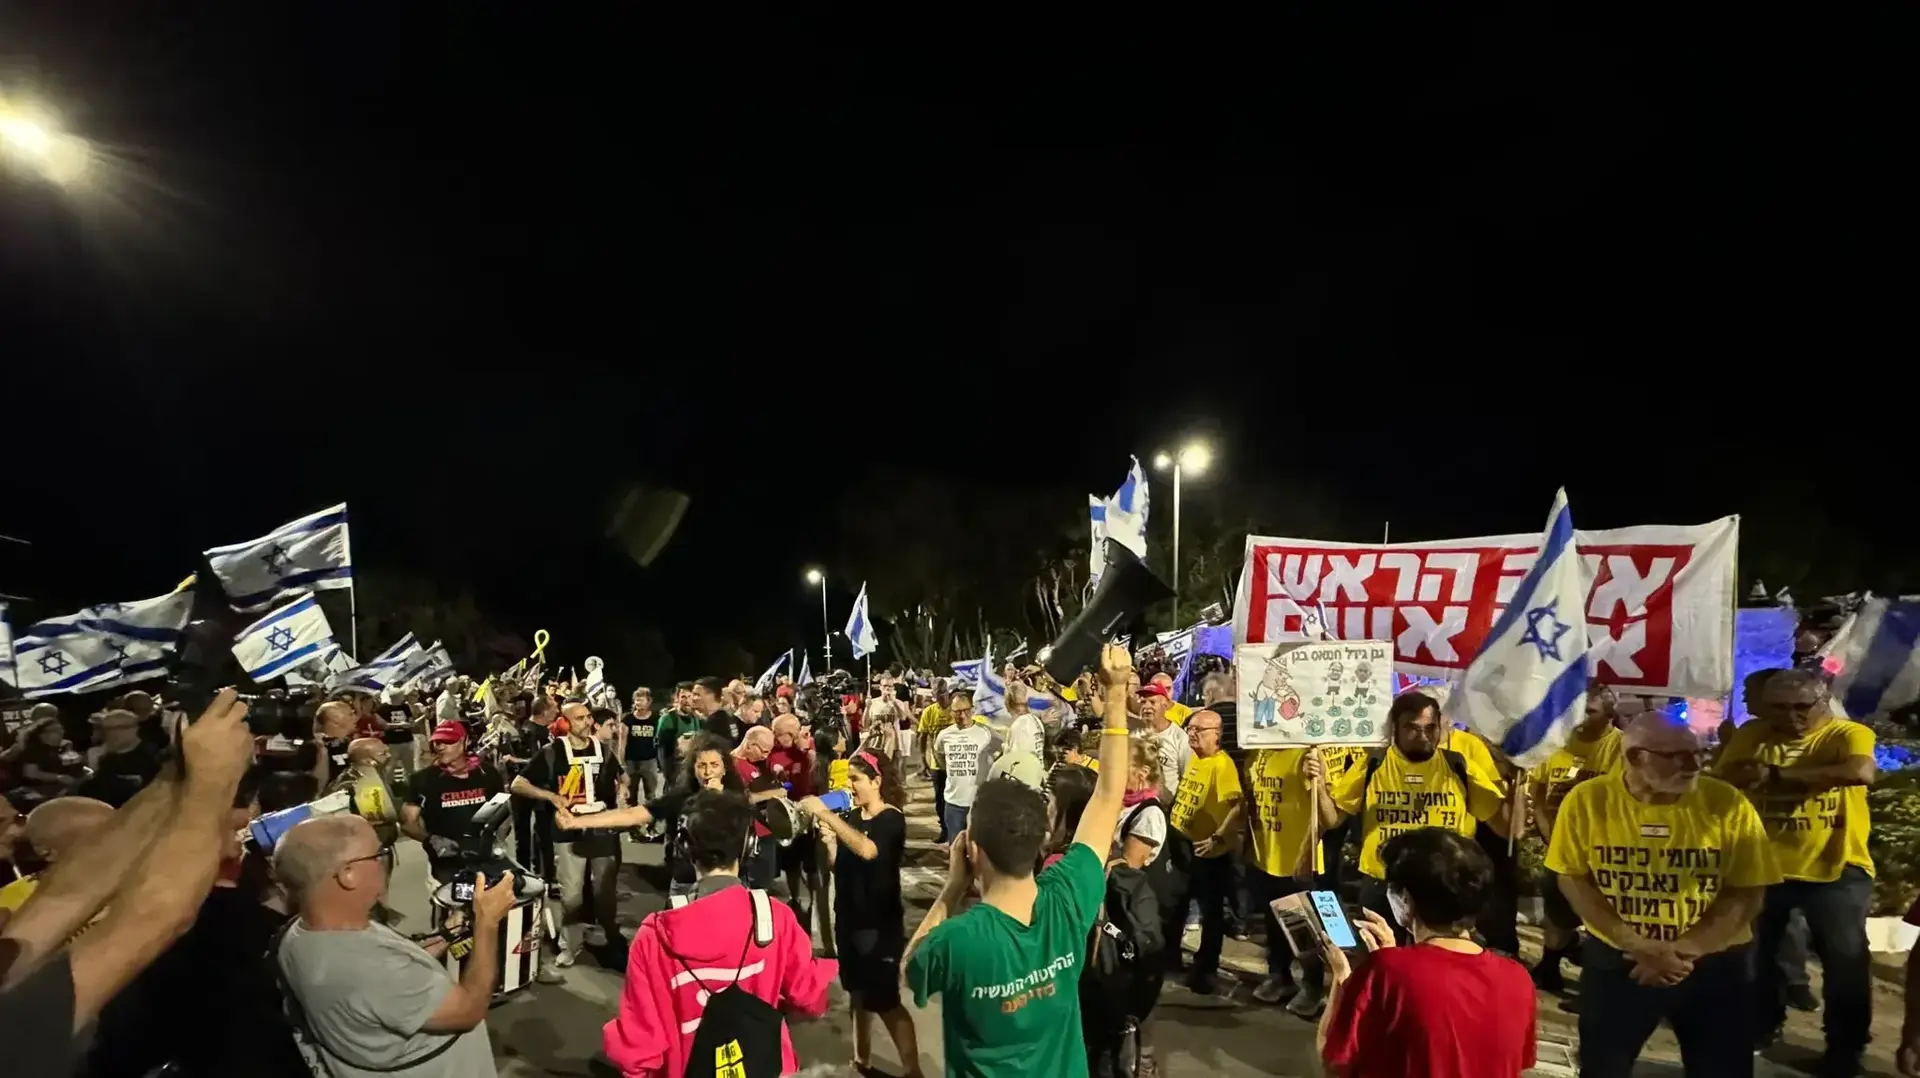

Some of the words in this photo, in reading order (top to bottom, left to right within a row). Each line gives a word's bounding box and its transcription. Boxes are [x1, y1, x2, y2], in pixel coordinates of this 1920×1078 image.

[1266, 552, 1481, 602] הראש
[1375, 791, 1411, 805] כיפור
[1376, 808, 1429, 825] נאבקים
[1593, 845, 1650, 868] כיפור
[1659, 846, 1721, 869] לוחמי
[1597, 869, 1679, 893] נאבקים
